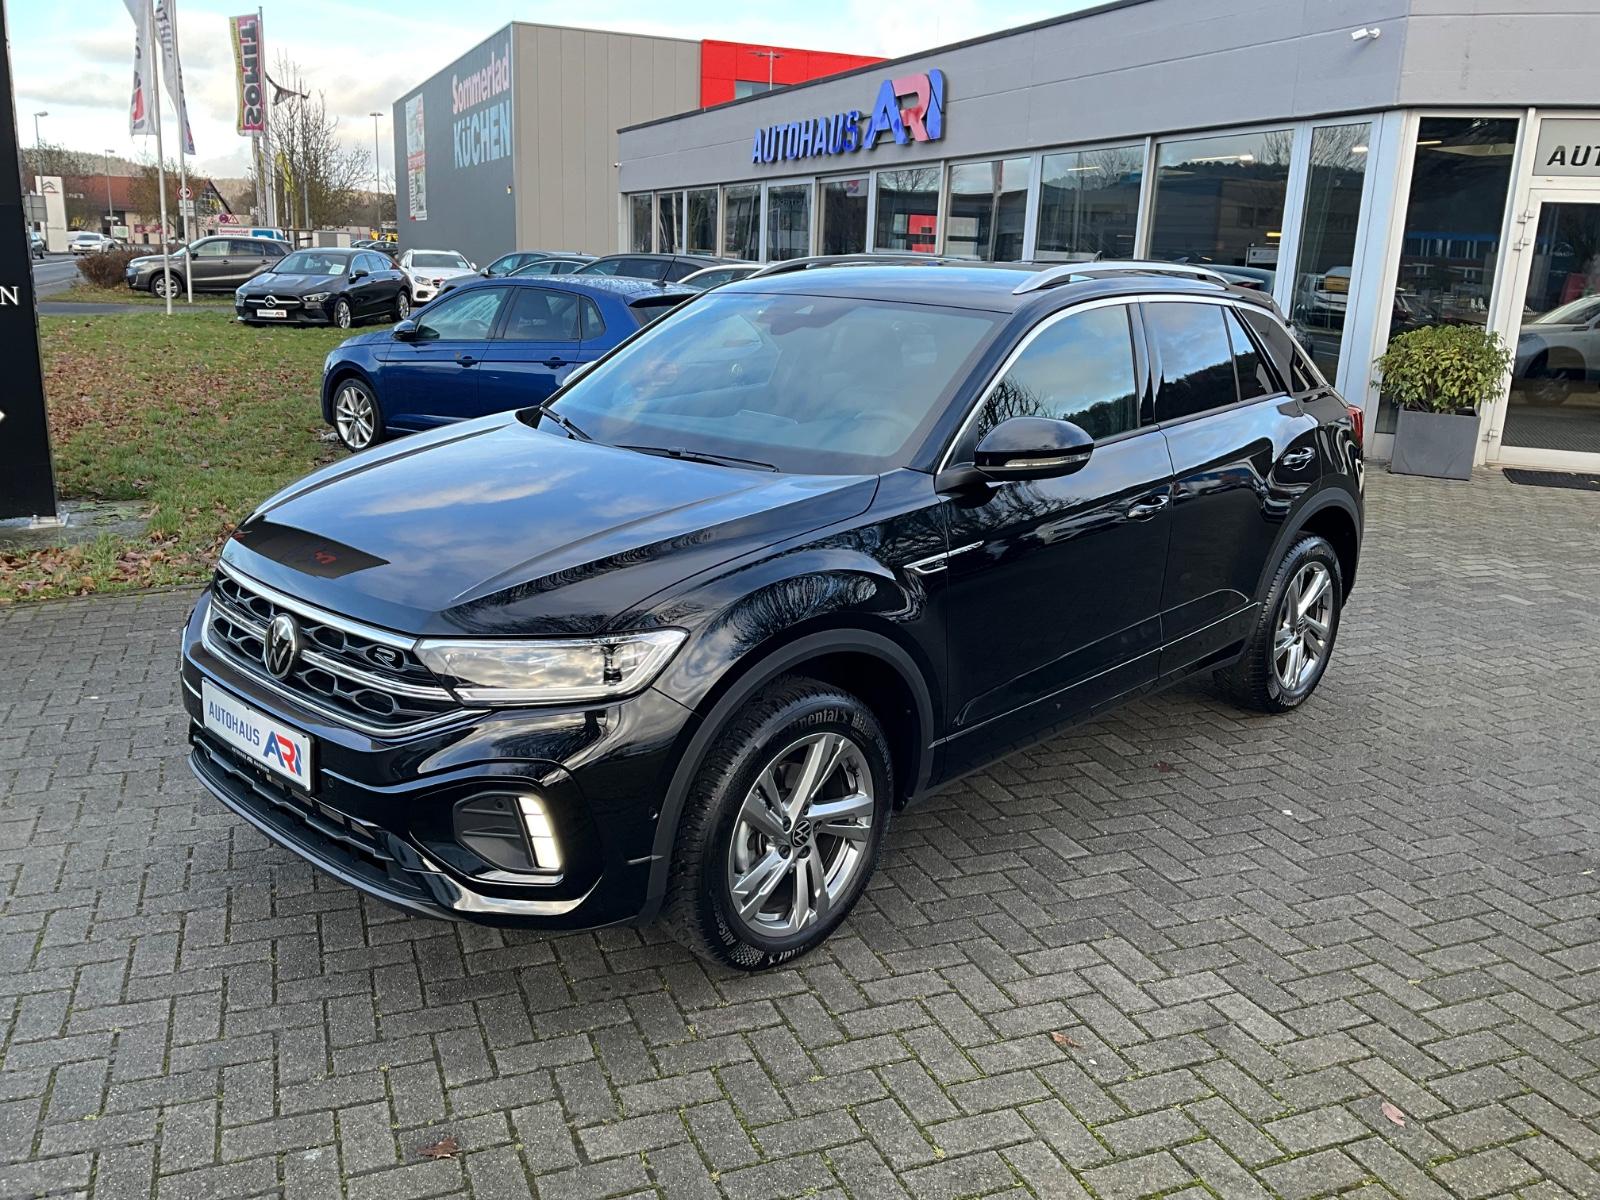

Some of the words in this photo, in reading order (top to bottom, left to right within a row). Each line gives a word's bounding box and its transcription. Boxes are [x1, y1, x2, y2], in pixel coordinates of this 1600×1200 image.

[452, 42, 510, 115] Sommerlad
[453, 99, 511, 169] KÜCHEN
[752, 110, 861, 164] AUTOHAUS
[208, 701, 260, 747] AUTOHAUS
